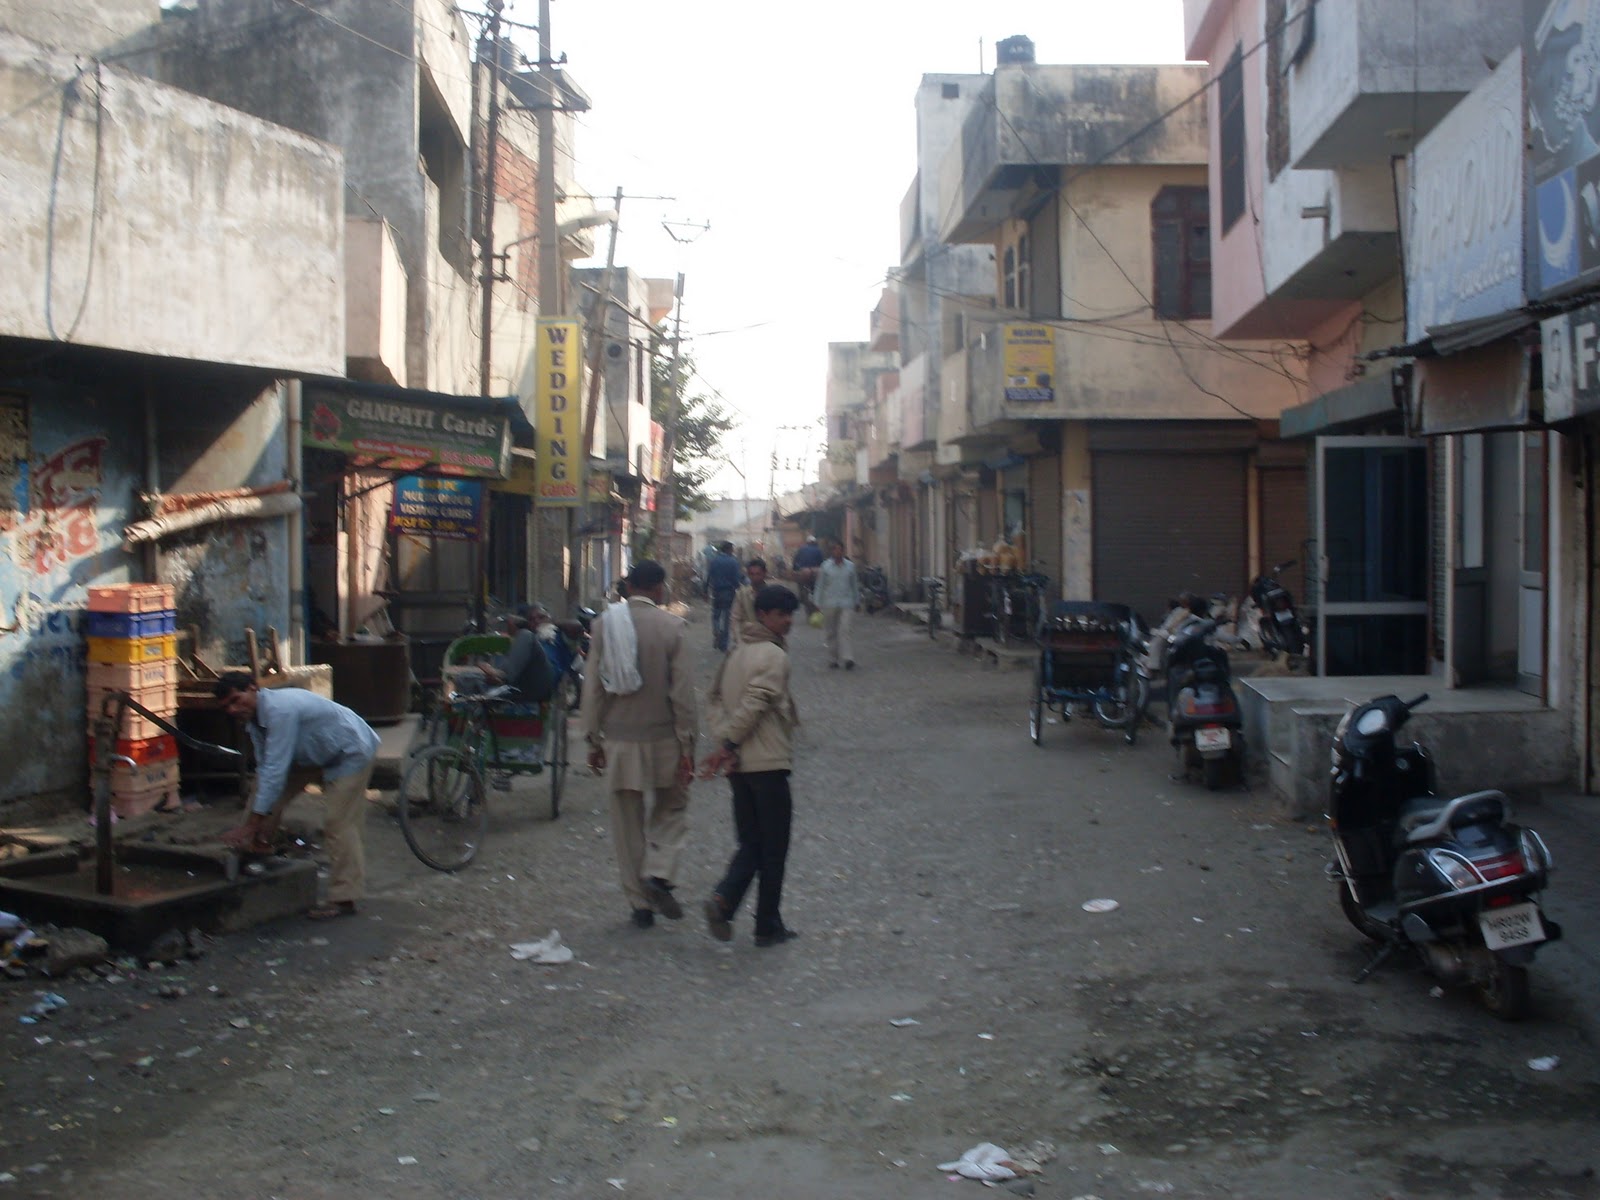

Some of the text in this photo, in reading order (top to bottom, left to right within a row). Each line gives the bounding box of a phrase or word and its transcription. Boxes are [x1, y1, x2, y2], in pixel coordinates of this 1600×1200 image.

[1575, 322, 1600, 389] F
[346, 400, 435, 429] GANPATI
[441, 412, 497, 438] Cards
[546, 327, 568, 480] WEDDING
